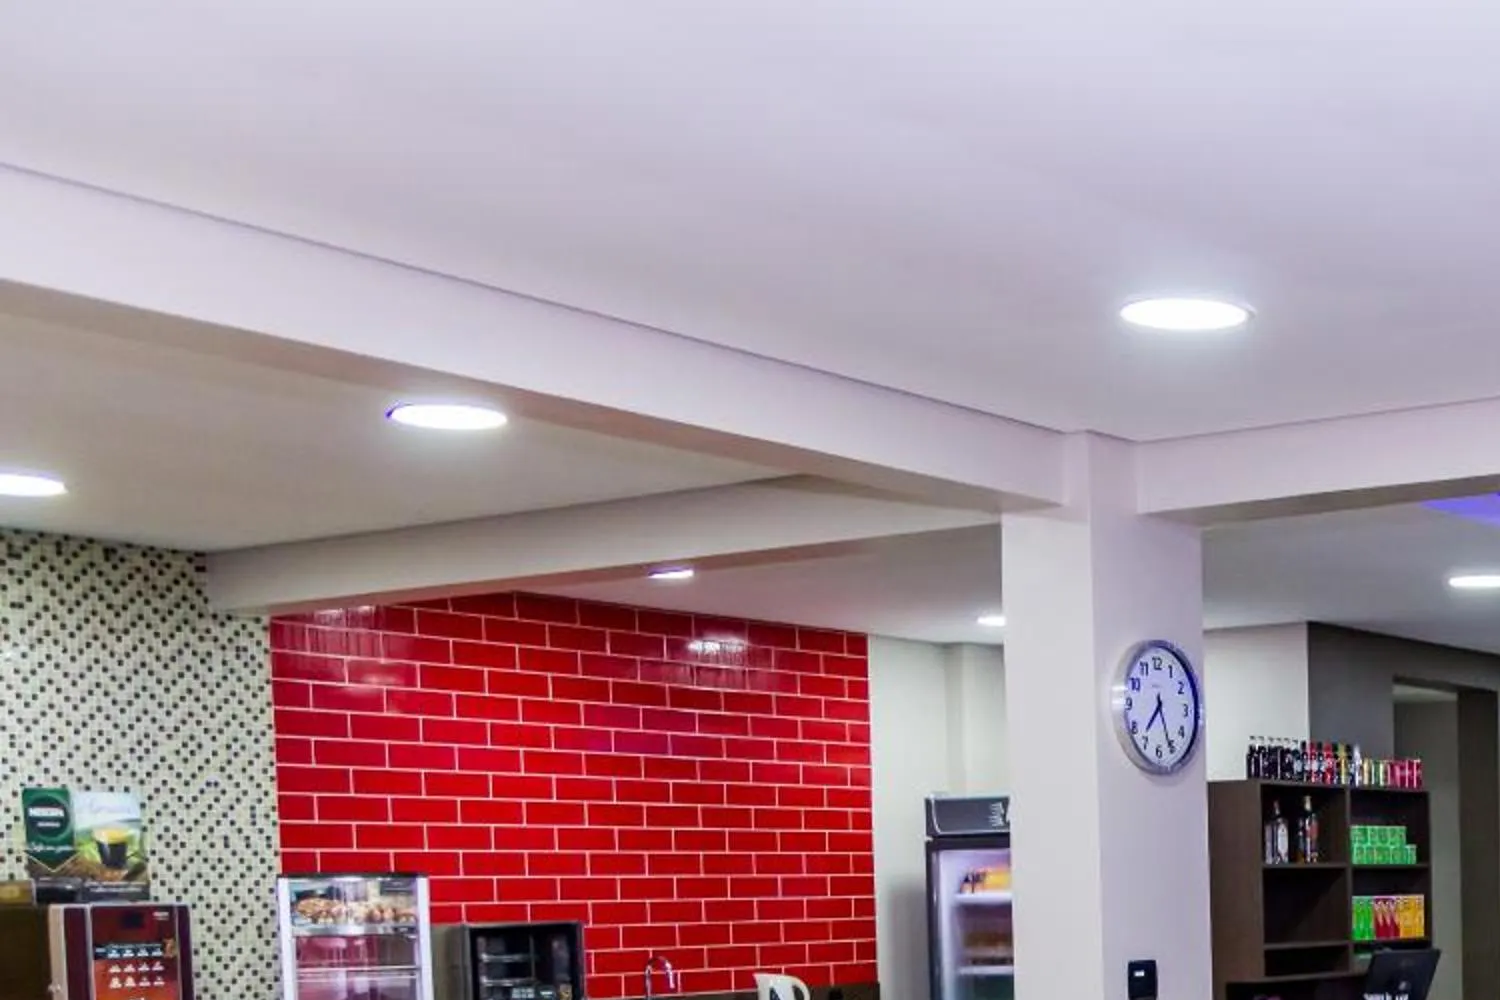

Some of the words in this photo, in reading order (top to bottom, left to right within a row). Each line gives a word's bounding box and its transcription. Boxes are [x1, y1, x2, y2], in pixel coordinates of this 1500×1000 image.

[1140, 661, 1149, 676] 11
[1152, 656, 1163, 670] 12
[1168, 664, 1173, 679] 1
[1130, 678, 1141, 691] 10
[1178, 681, 1185, 695] 2
[1125, 697, 1133, 711] 9
[1183, 703, 1189, 718] 3
[1131, 721, 1138, 734] 8
[1178, 725, 1185, 739] 4
[1142, 735, 1149, 750] 7
[1169, 740, 1176, 754] 5
[1155, 744, 1163, 759] 6
